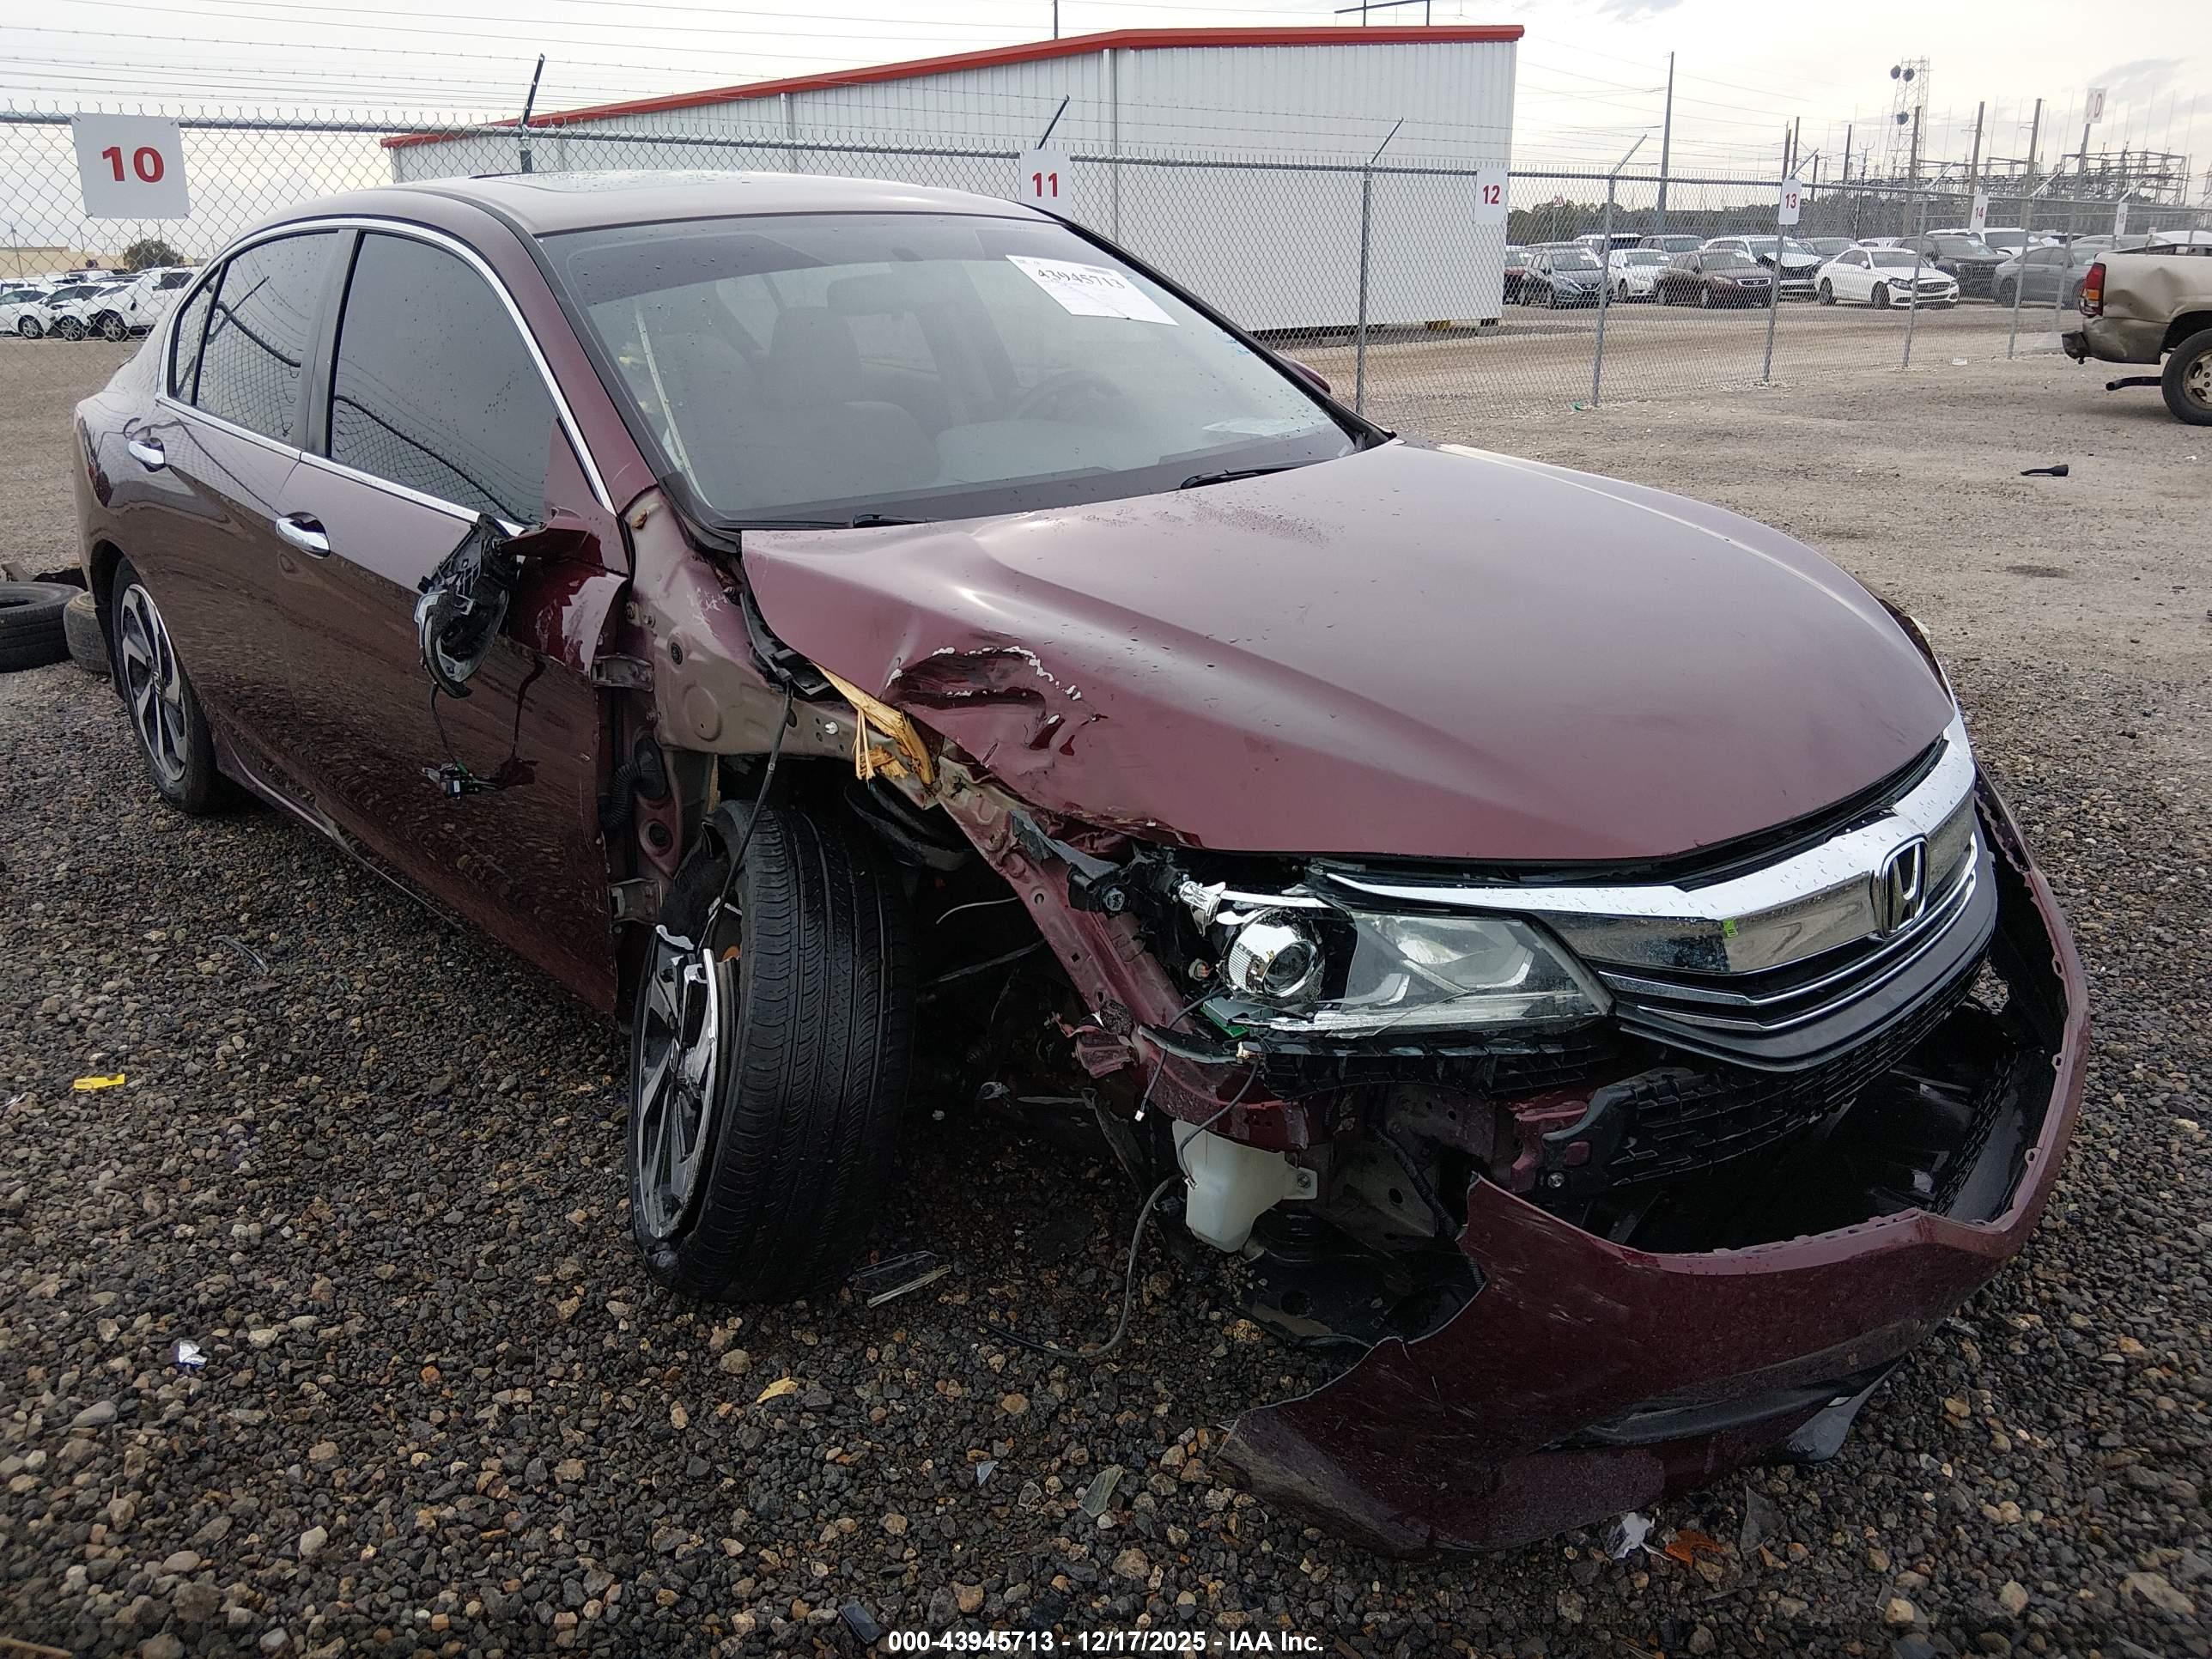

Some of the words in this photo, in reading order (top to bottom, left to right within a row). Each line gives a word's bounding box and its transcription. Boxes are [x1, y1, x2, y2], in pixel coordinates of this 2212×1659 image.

[102, 146, 165, 183] 10
[1032, 172, 1058, 198] 11
[1483, 185, 1500, 204] 12
[1785, 193, 1797, 209] 13
[1975, 206, 1984, 220] 14
[1038, 269, 1126, 289] 43945713
